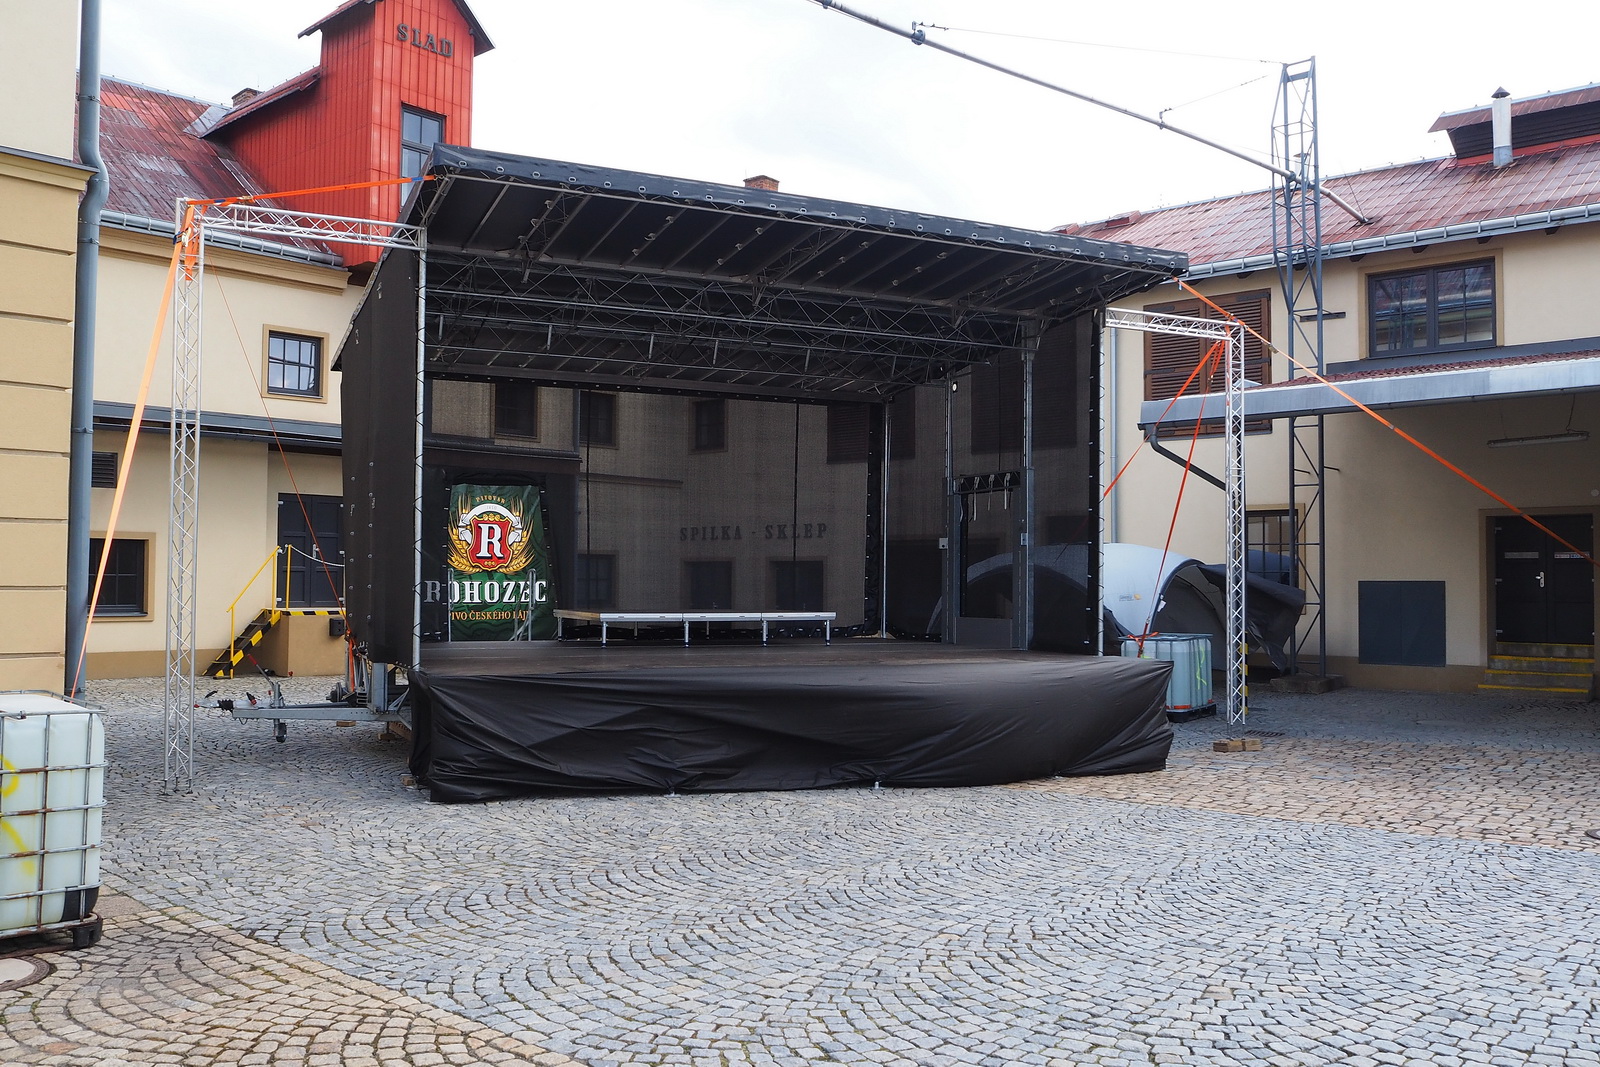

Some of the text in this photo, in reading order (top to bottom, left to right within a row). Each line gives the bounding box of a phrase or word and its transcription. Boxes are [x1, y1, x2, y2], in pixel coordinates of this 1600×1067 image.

[396, 23, 453, 57] SLAD
[476, 523, 504, 559] R
[680, 525, 742, 541] SPILKA
[765, 523, 827, 539] SKLEP
[449, 611, 468, 620] IVO
[469, 609, 510, 620] ČESKÉHO
